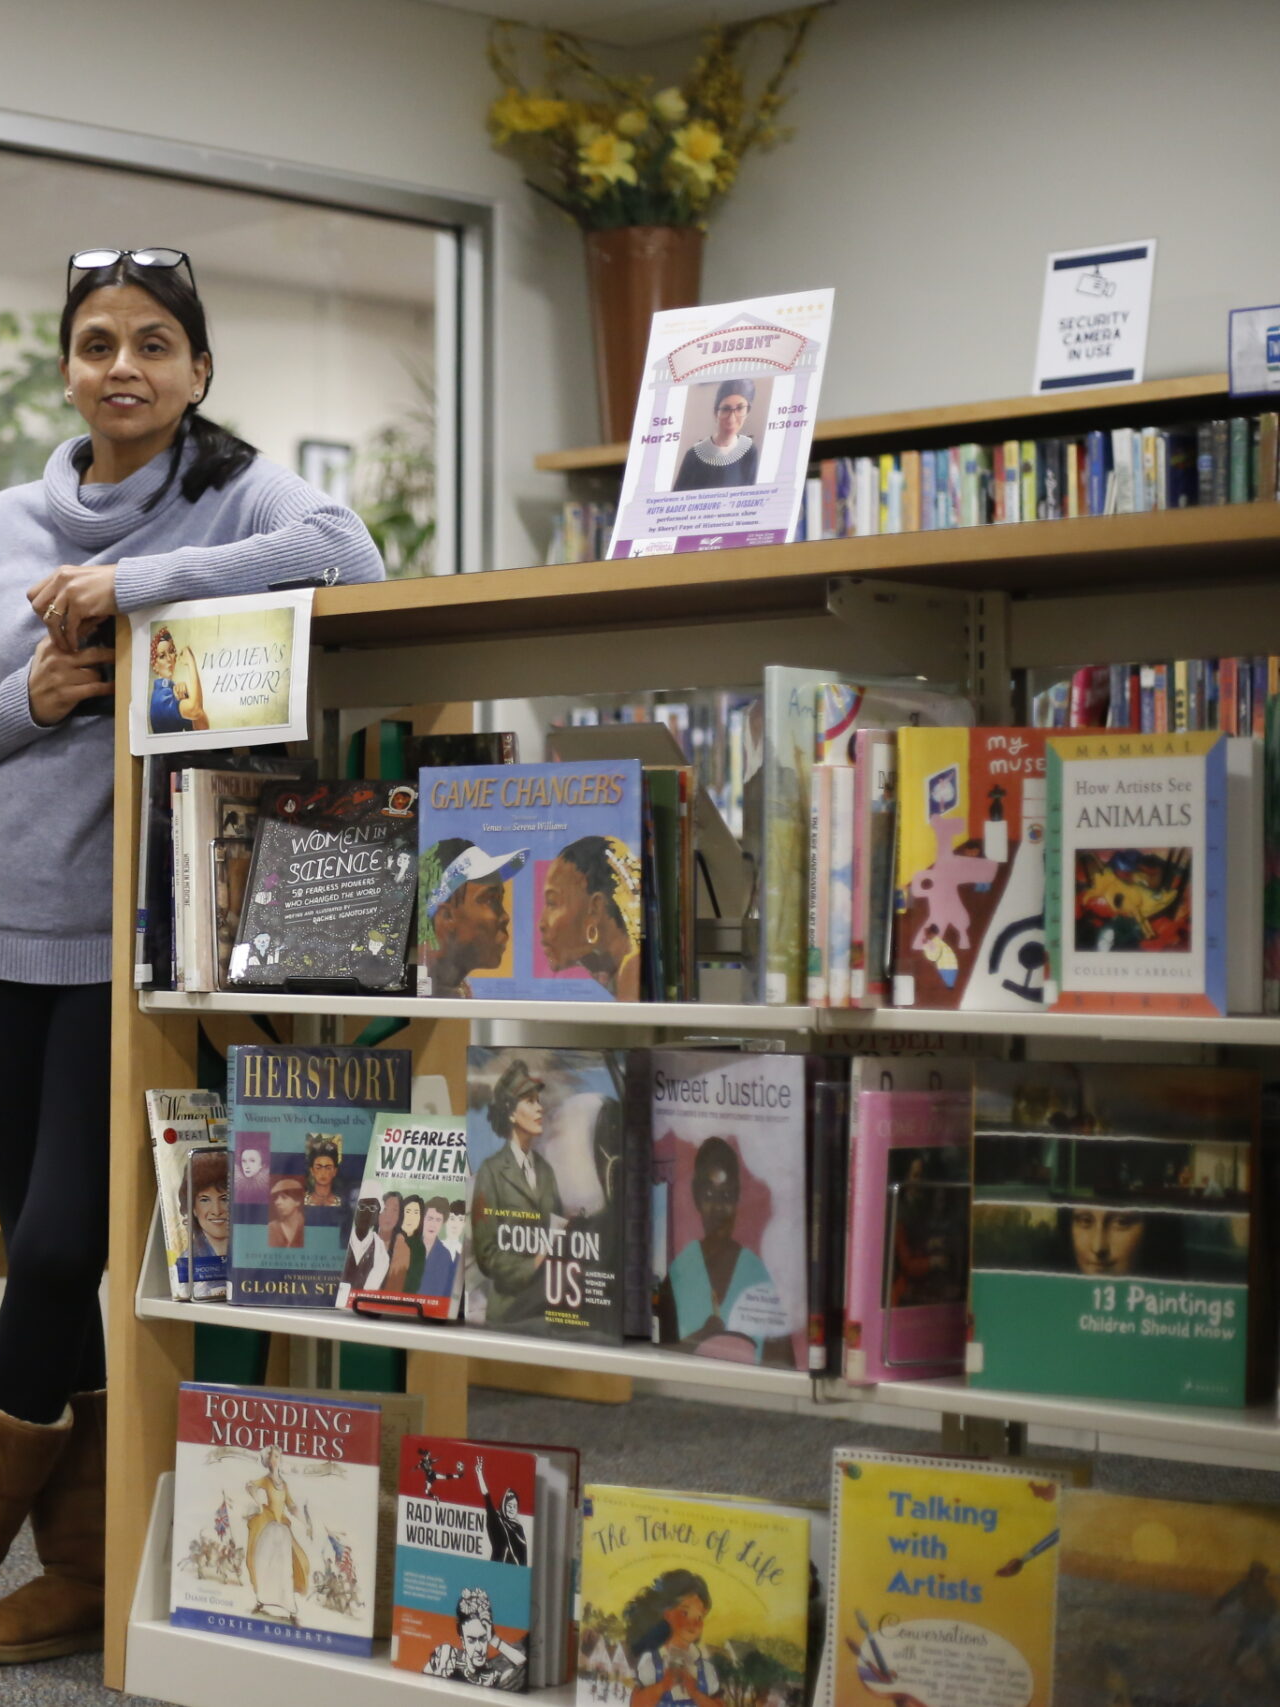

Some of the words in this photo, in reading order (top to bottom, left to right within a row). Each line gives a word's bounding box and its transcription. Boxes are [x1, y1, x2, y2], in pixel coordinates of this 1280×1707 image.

[1058, 311, 1131, 331] SECURITY
[1063, 328, 1121, 346] CAMERA
[1068, 350, 1081, 360] IN
[1085, 344, 1112, 358] USE
[653, 416, 673, 426] Sat
[768, 420, 791, 430] 11:30
[641, 434, 665, 444] Mar
[665, 432, 680, 441] 25
[201, 643, 286, 670] WOMEN'S
[212, 668, 289, 693] HISTORY
[239, 694, 269, 706] MONTH
[431, 778, 498, 810] GAME
[500, 774, 626, 808] CHANGERS
[1076, 781, 1110, 795] How
[1118, 780, 1163, 795] Artists
[1168, 777, 1192, 792] See
[512, 823, 535, 831] Serena
[1076, 804, 1191, 828] ANIMALS
[292, 826, 370, 854] WOMEN
[374, 827, 387, 838] IN
[287, 850, 383, 884] SCIENCE
[285, 899, 302, 908] WHO
[305, 894, 339, 905] CHANGED
[356, 888, 381, 896] WORLD
[292, 888, 303, 898] 50
[305, 883, 339, 895] FEARLESS
[341, 877, 375, 888] PIONEERS
[312, 914, 336, 924] RACHEL
[243, 1055, 400, 1101] HERSTORY
[655, 1070, 709, 1104] Sweet
[716, 1074, 791, 1108] Justice
[245, 1112, 280, 1123] Women
[284, 1114, 306, 1124] Who
[308, 1114, 350, 1128] Changed
[352, 1115, 366, 1125] the
[179, 1131, 202, 1140] REAT
[384, 1128, 401, 1143] 50
[403, 1130, 466, 1146] FEARLES
[380, 1146, 467, 1174] WOMEN
[512, 1211, 541, 1220] NATHAN
[498, 1224, 566, 1256] COUNT
[571, 1231, 600, 1261] ON
[241, 1280, 307, 1295] GLORIA
[546, 1260, 581, 1307] US
[585, 1271, 615, 1280] AMERICAN
[585, 1280, 606, 1288] WOMEN
[585, 1298, 611, 1306] MILITARY
[1093, 1285, 1116, 1311] 13
[1127, 1285, 1235, 1325] Paintings
[1079, 1315, 1136, 1333] Children
[1141, 1318, 1190, 1338] Should
[1194, 1324, 1235, 1339] Know
[205, 1394, 351, 1434] FOUNDING
[210, 1420, 344, 1459] MOTHERS
[406, 1502, 432, 1523] RAD
[435, 1505, 484, 1532] WOMEN
[889, 1491, 998, 1533] Talking
[406, 1524, 483, 1555] WORLDWIDE
[592, 1523, 629, 1555] The
[636, 1515, 699, 1546] Tower
[706, 1528, 731, 1564] of
[736, 1539, 785, 1587] Life
[888, 1531, 947, 1560] with
[886, 1570, 983, 1603] Artists
[208, 1616, 253, 1631] COKIE
[264, 1625, 333, 1644] ROBERTS
[878, 1613, 988, 1646] Conversations
